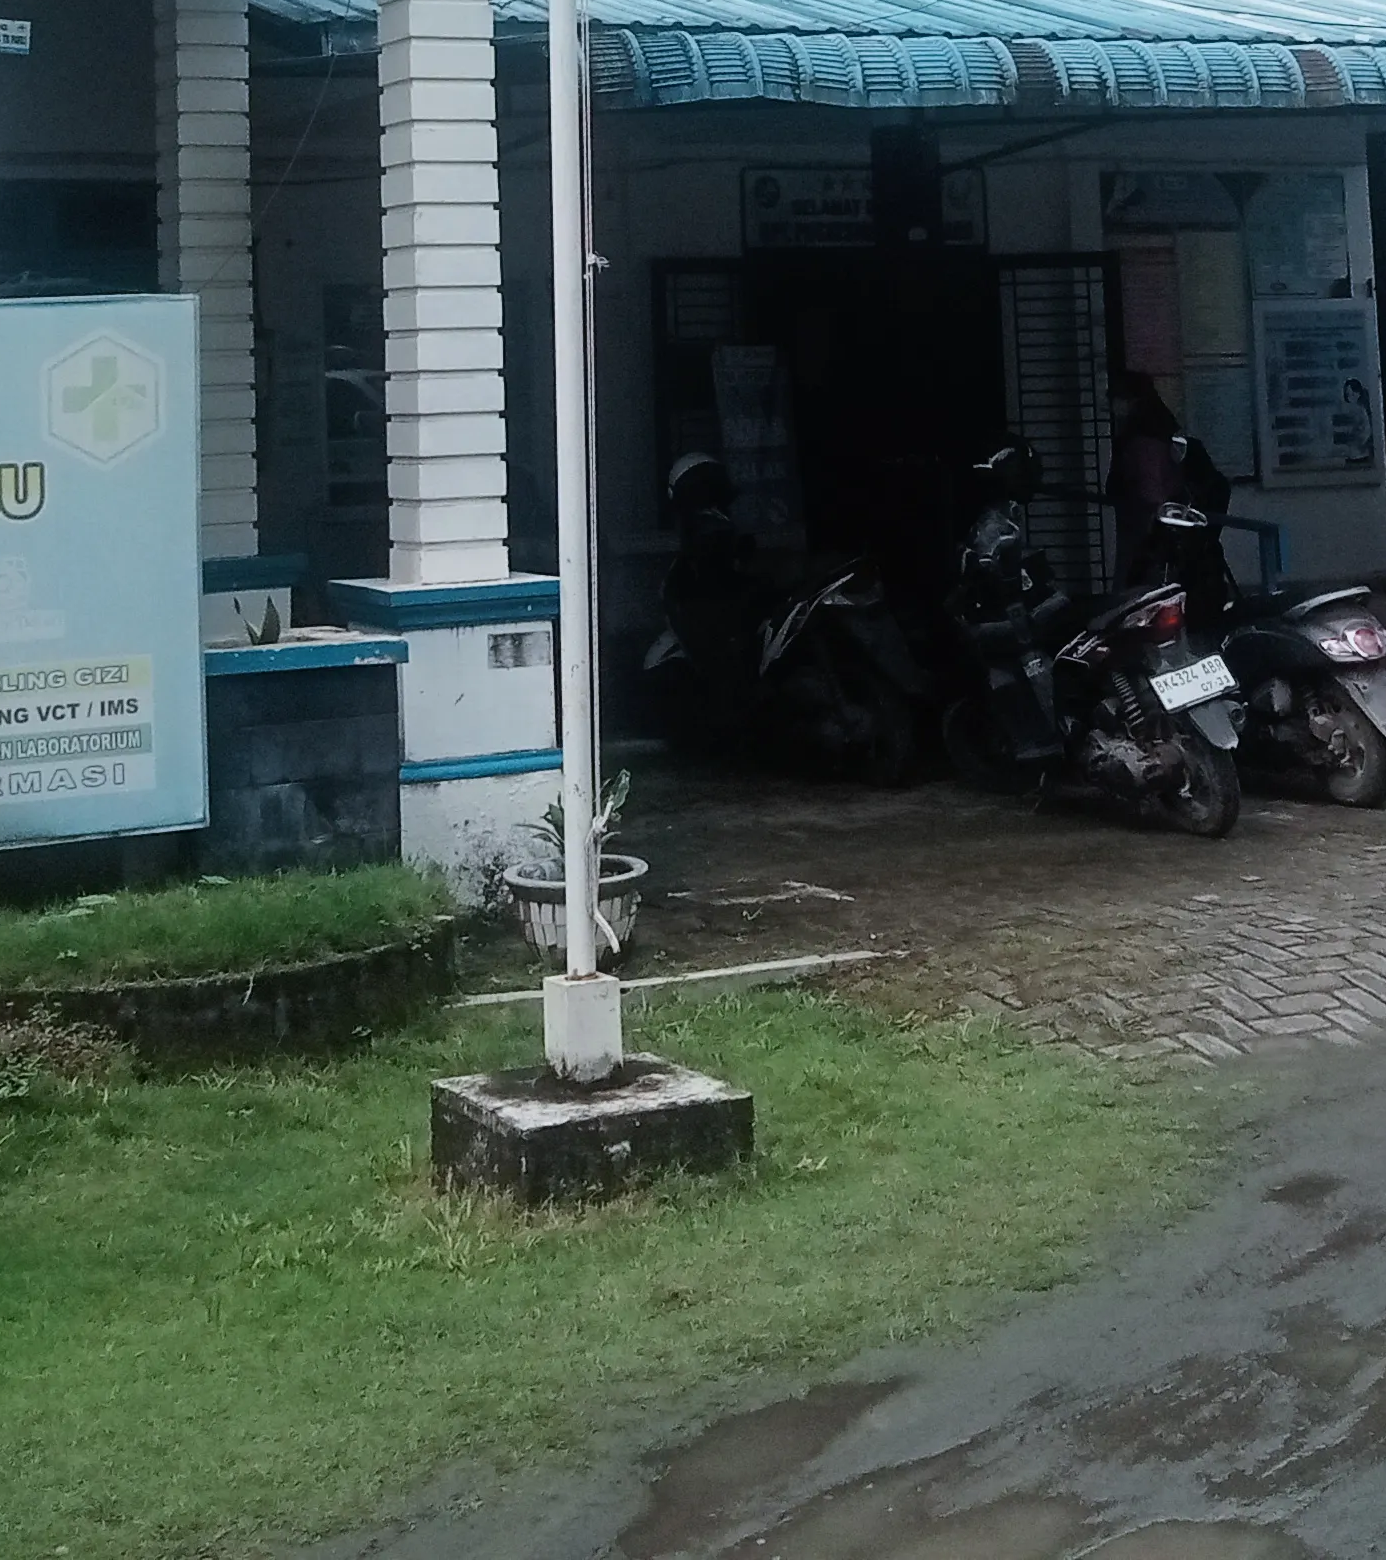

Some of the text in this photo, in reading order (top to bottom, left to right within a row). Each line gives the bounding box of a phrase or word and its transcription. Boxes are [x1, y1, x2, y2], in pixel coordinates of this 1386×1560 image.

[73, 664, 129, 686] GIZI
[36, 702, 81, 722] VCT
[99, 697, 139, 717] IMS
[16, 729, 142, 759] LABORATORIUM
